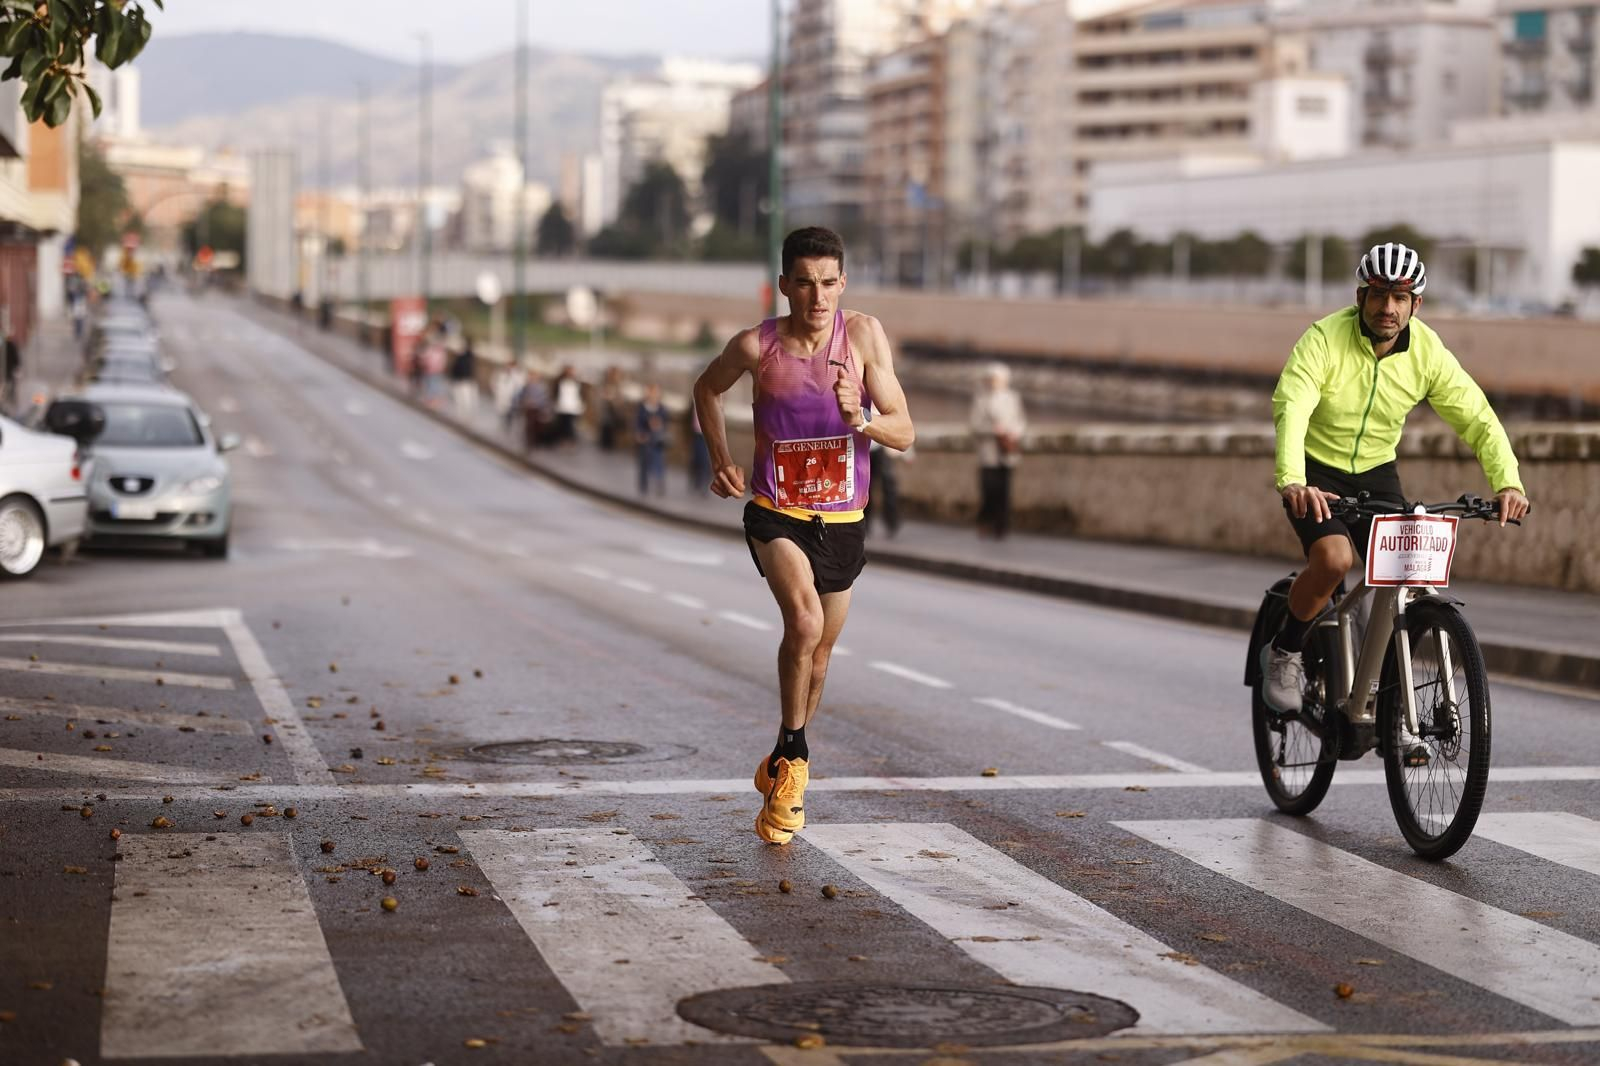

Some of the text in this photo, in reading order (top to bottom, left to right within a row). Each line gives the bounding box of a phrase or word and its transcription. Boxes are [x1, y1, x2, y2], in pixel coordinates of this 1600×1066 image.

[793, 440, 841, 452] GENERALI
[806, 457, 817, 466] 26
[1380, 535, 1448, 552] AUTORIZADO
